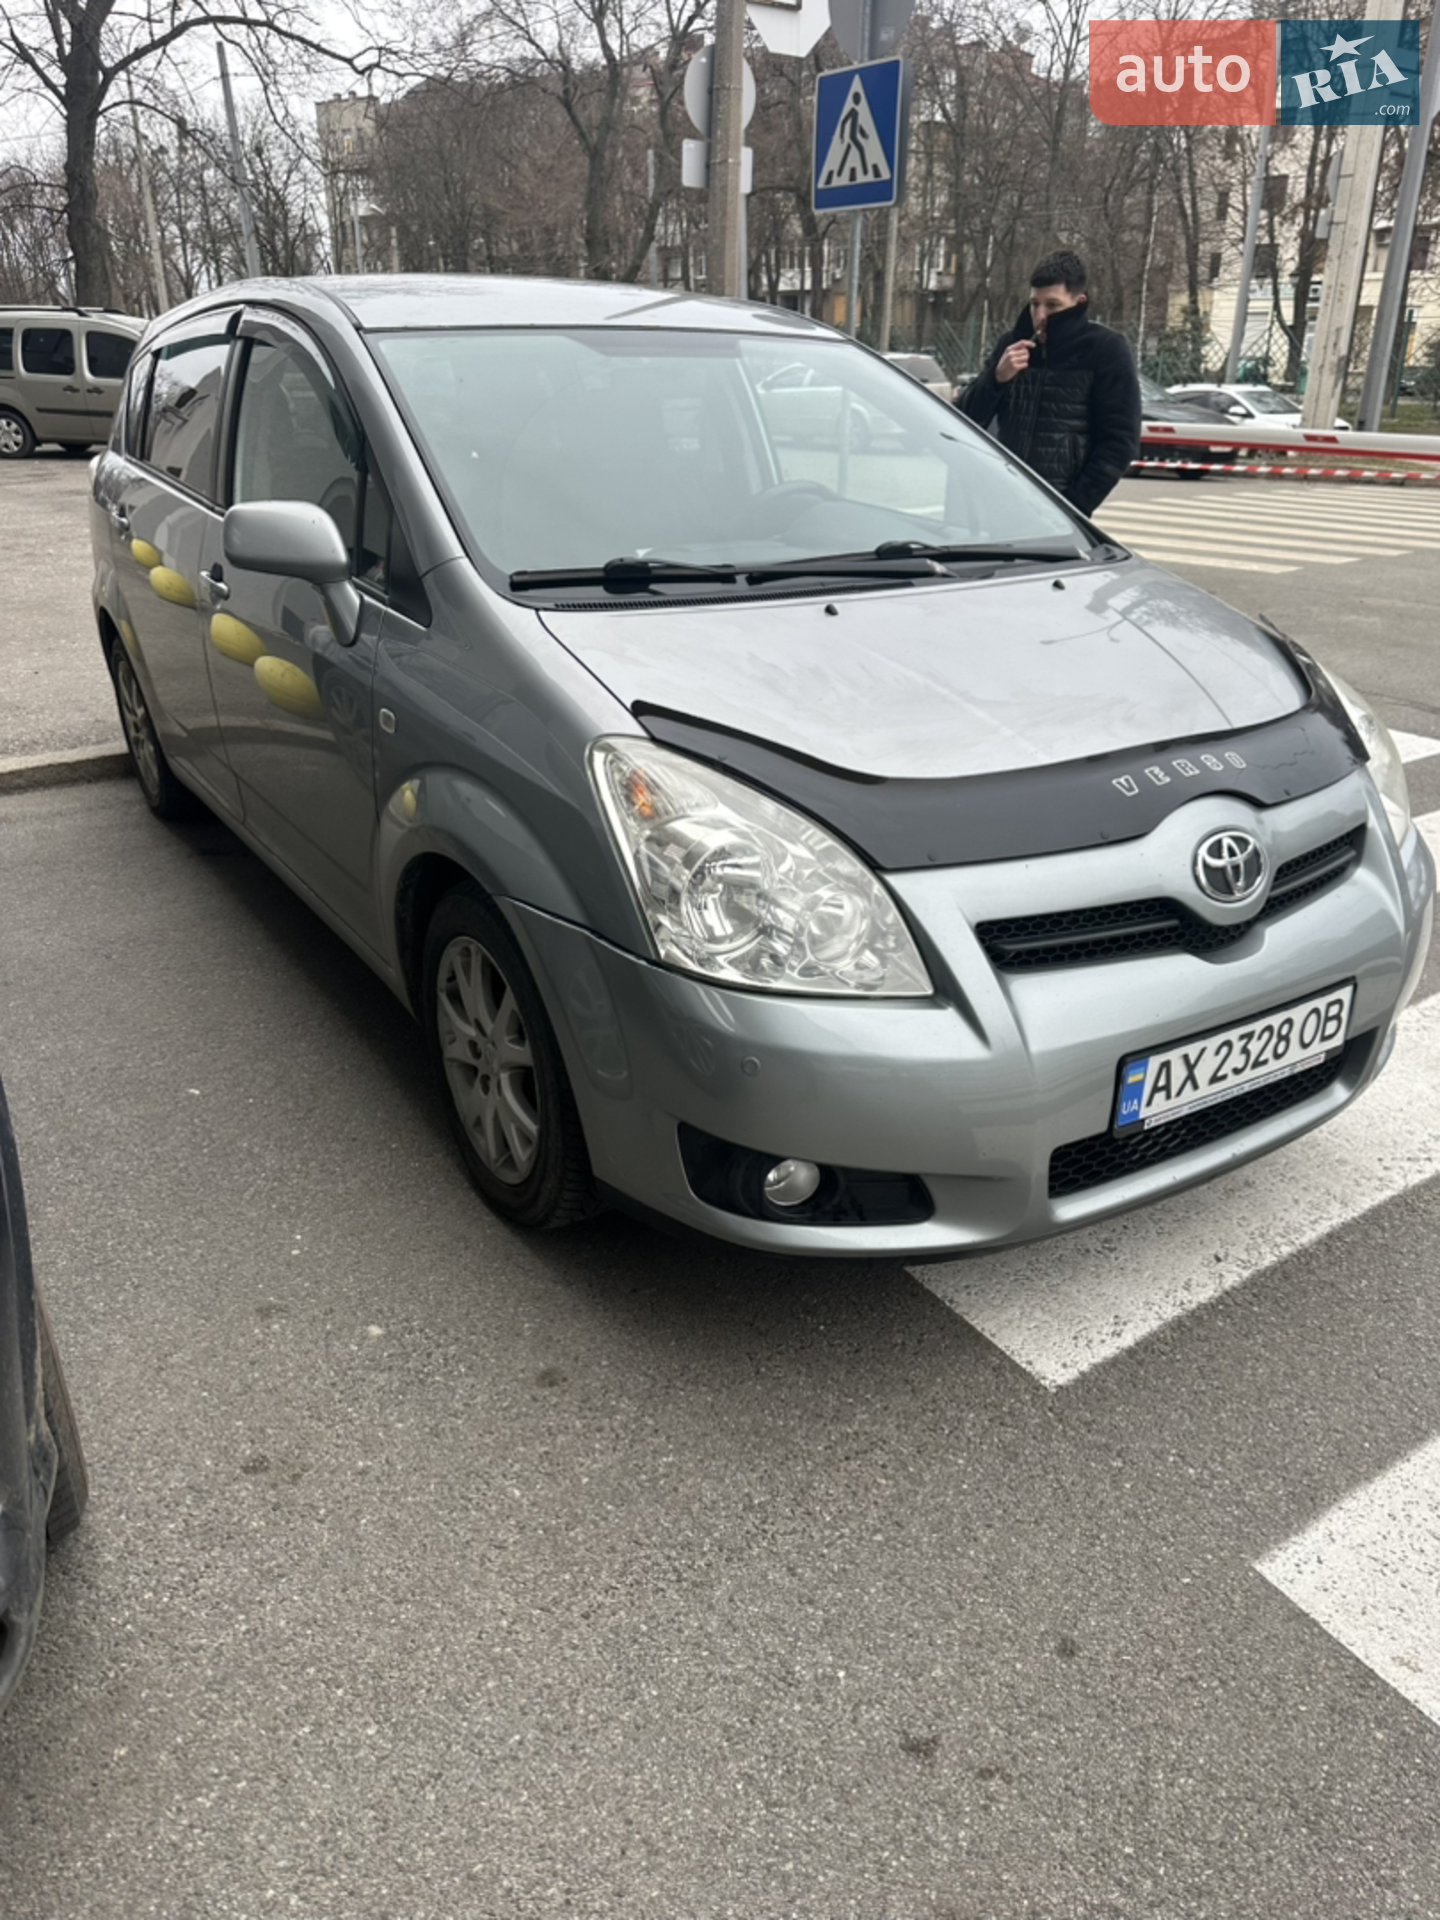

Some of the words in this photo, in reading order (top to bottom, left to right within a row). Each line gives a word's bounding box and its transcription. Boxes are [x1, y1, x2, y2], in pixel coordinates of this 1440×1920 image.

[1112, 751, 1247, 797] VERSO
[1145, 1046, 1208, 1108] AX
[1208, 1017, 1294, 1086] 2328
[1299, 998, 1345, 1050] OB
[1121, 1100, 1139, 1115] UA
